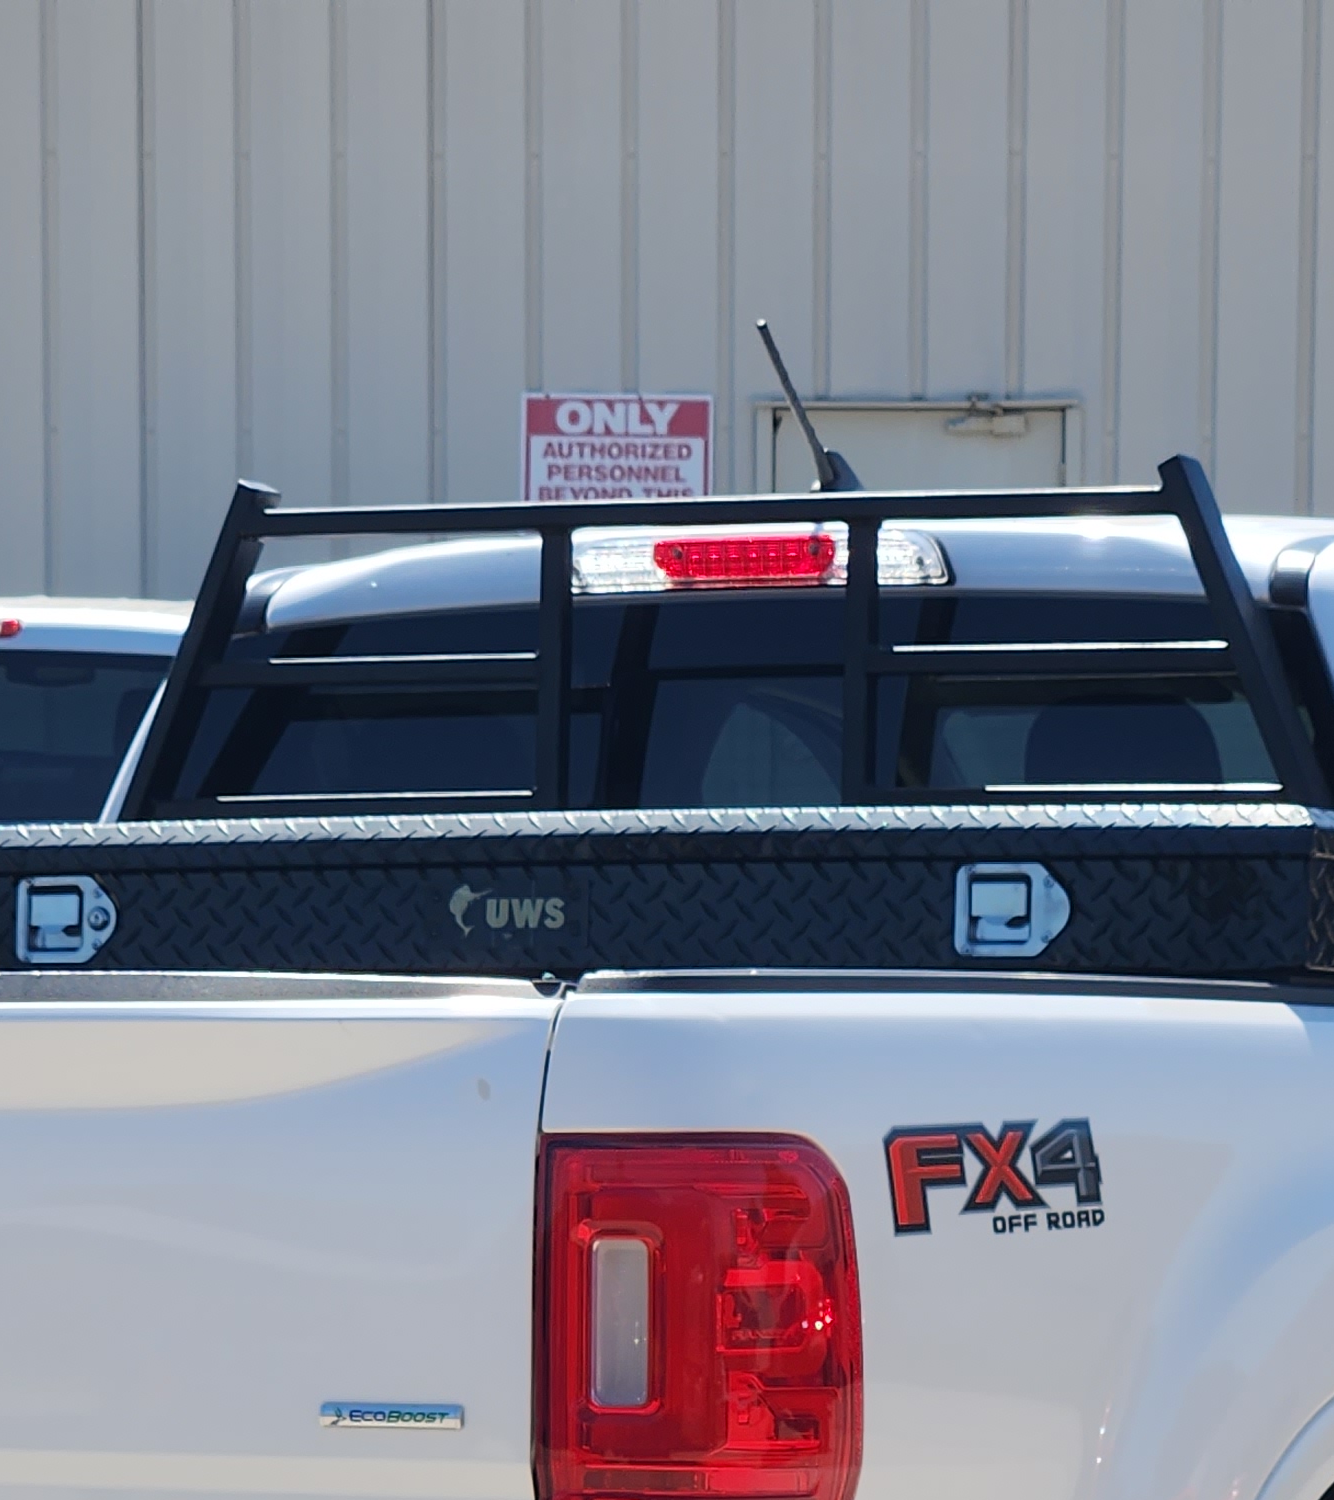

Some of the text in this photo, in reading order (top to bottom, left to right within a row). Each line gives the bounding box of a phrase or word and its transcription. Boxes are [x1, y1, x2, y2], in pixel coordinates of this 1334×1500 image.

[555, 402, 681, 435] ONLY
[542, 442, 692, 461] AUTHORIZED
[547, 464, 687, 482] PERSONNEL
[538, 486, 633, 502] BEYOND
[486, 897, 565, 929] UWS
[882, 1117, 1103, 1236] FX4
[992, 1209, 1105, 1234] OFF ROAD
